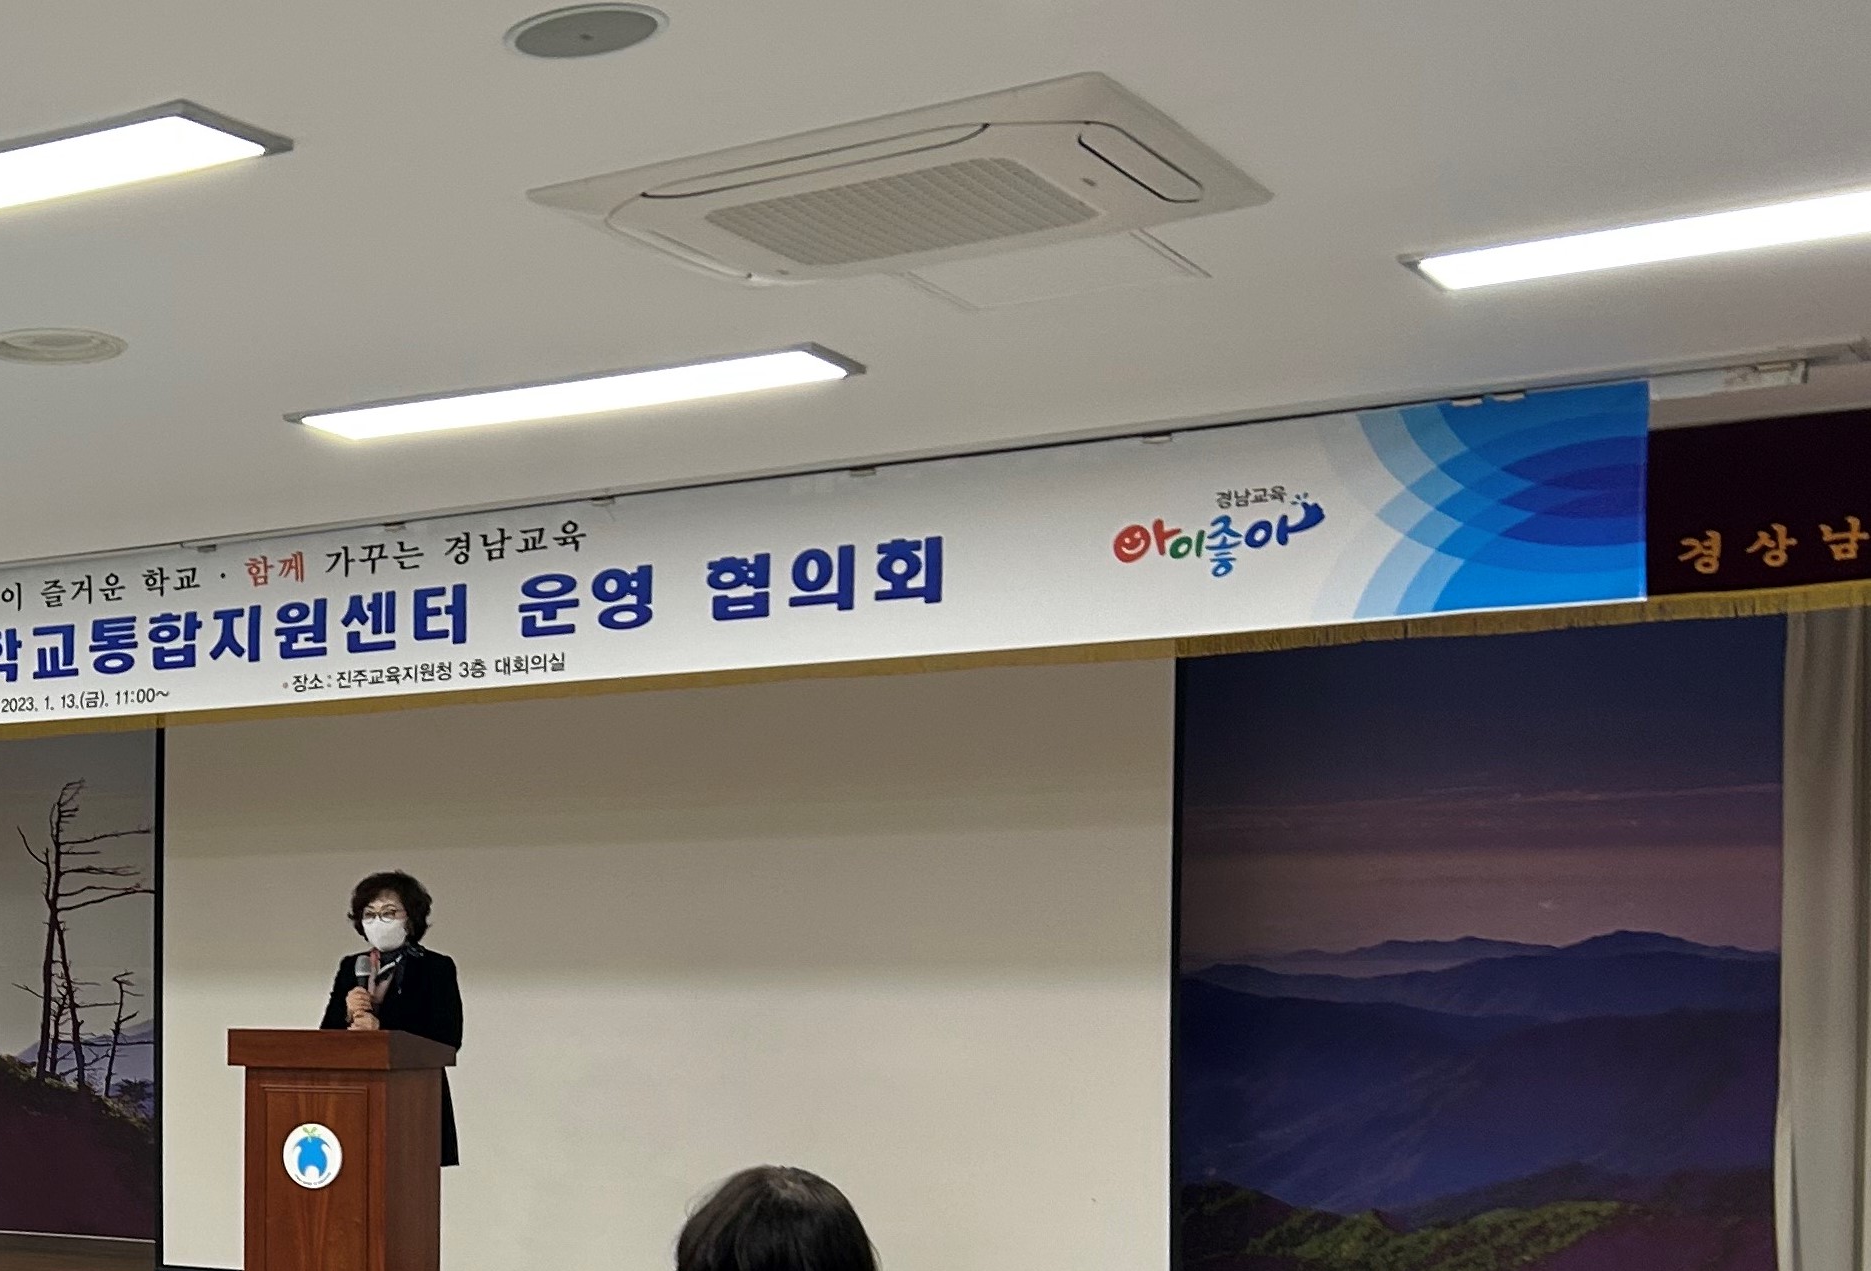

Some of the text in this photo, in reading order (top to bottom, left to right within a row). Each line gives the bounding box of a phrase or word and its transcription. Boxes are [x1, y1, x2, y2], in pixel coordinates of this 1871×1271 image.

[1215, 484, 1288, 510] 경남교육
[40, 571, 126, 608] 즐거운
[142, 565, 202, 597] 학교
[243, 550, 305, 588] 함께
[325, 540, 425, 578] 가꾸는
[443, 519, 587, 565] 경남교육
[1113, 500, 1326, 578] 아이좋아
[517, 565, 653, 638] 운영
[707, 536, 943, 622] 협의회
[336, 661, 452, 689] 진주교육지원청
[458, 658, 488, 679] 3층
[494, 651, 565, 676] 대회의실
